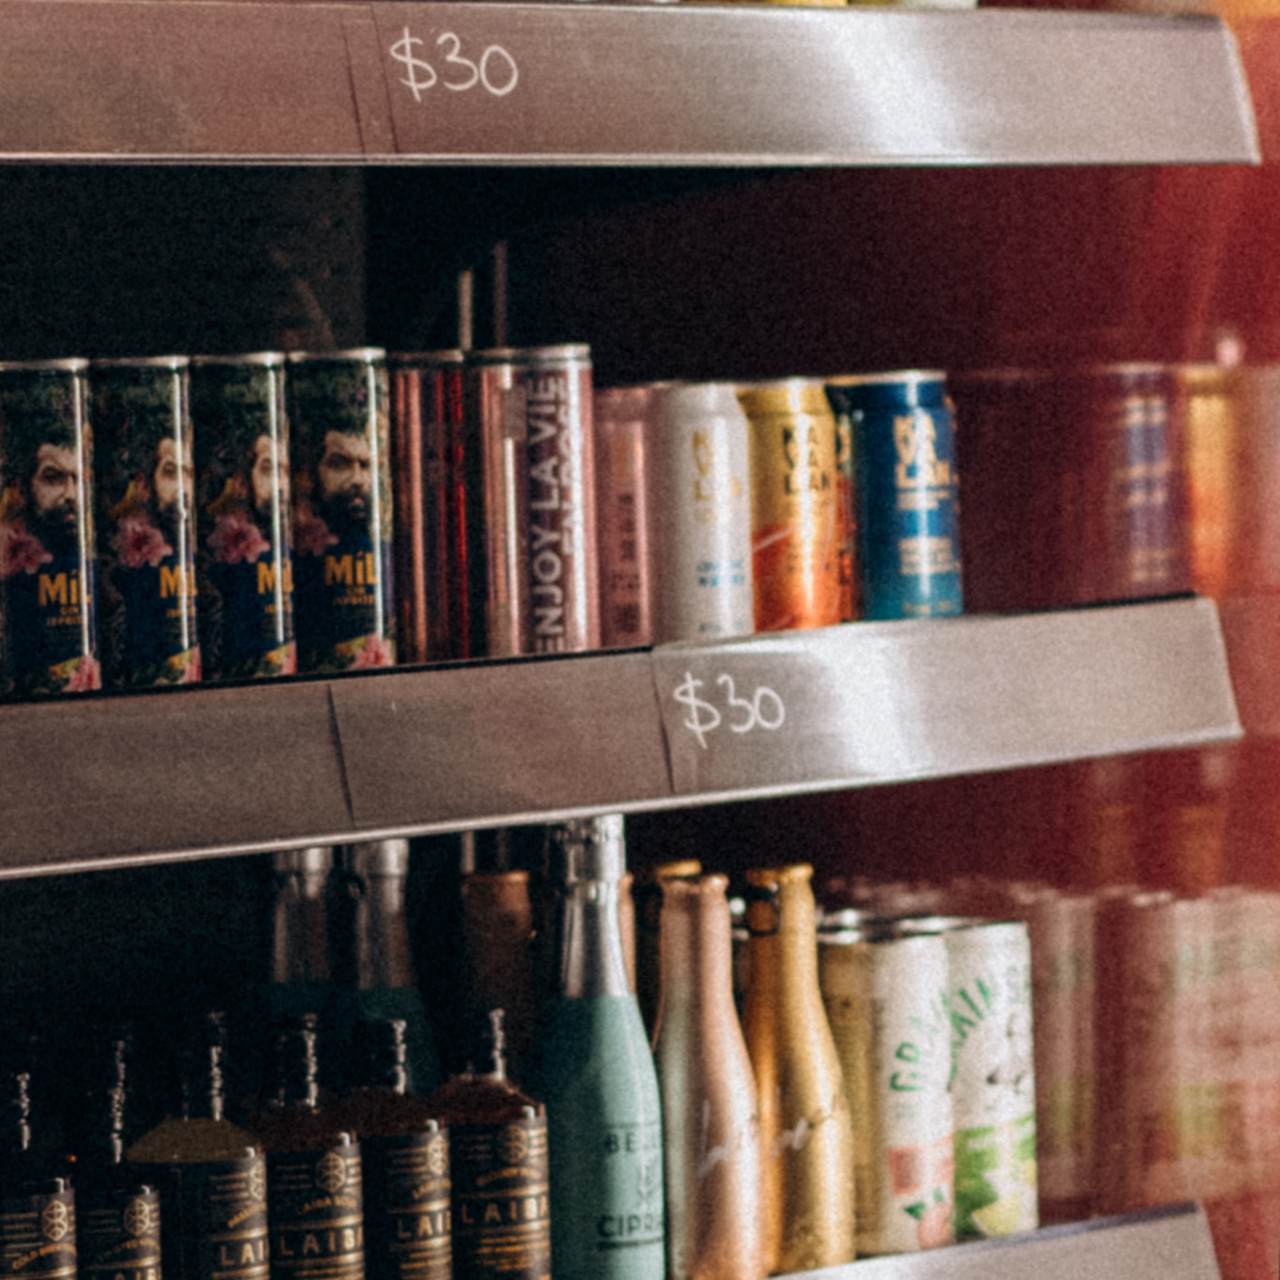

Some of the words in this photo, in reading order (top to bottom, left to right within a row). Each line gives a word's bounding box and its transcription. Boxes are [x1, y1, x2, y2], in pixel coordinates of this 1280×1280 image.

[390, 26, 518, 102] $30
[530, 456, 561, 511] LA
[674, 671, 786, 750] $30
